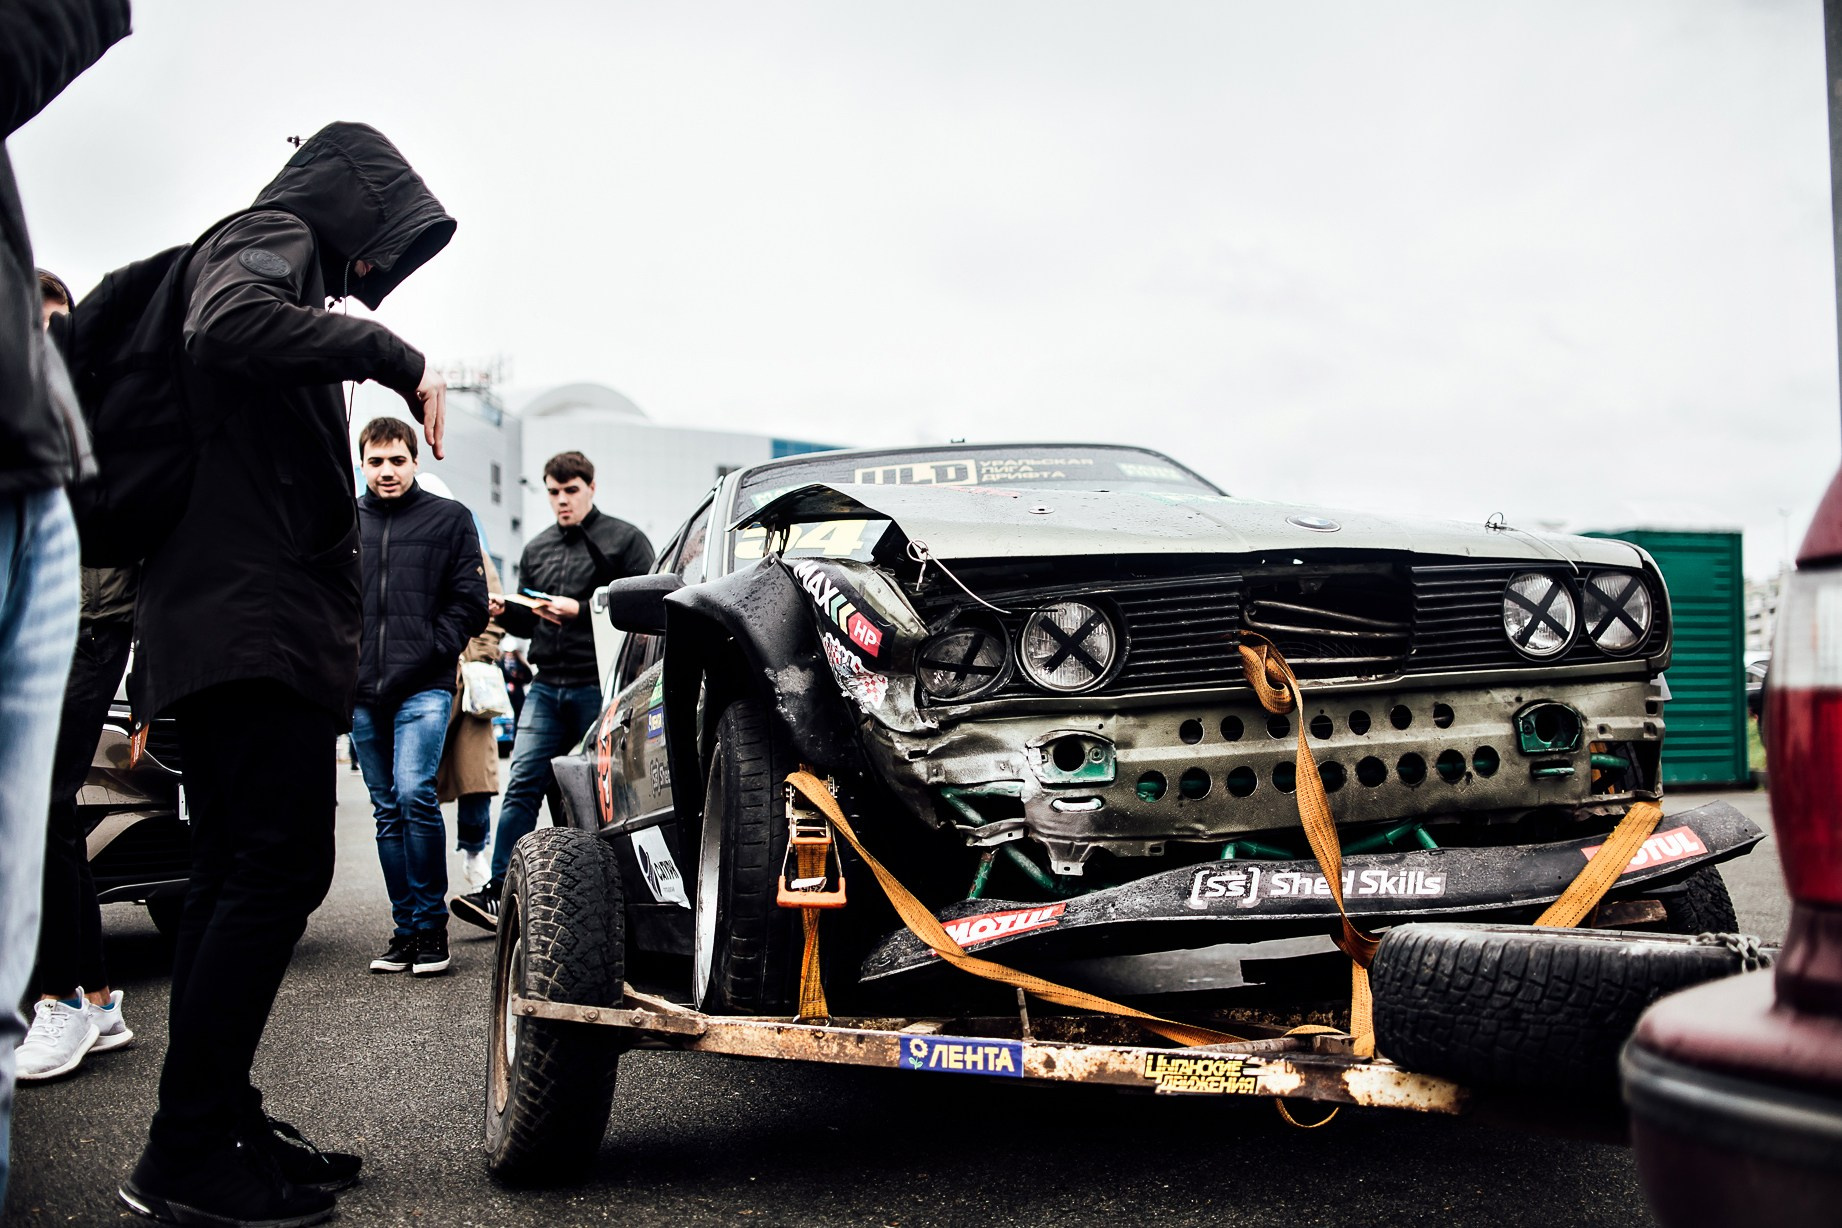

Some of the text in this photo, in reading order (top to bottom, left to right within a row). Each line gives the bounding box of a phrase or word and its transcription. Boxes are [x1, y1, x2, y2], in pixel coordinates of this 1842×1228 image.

[981, 471, 1066, 482] ДРИФТА
[793, 559, 878, 646] MAX HP
[1270, 871, 1355, 896] Shed
[1359, 869, 1443, 895] Skills
[928, 1044, 1015, 1072] ЛЕНТА
[1144, 1054, 1243, 1083] ЦЫГАНСКИЕ
[1158, 1075, 1256, 1094] ДВИЖЕНИЯ
